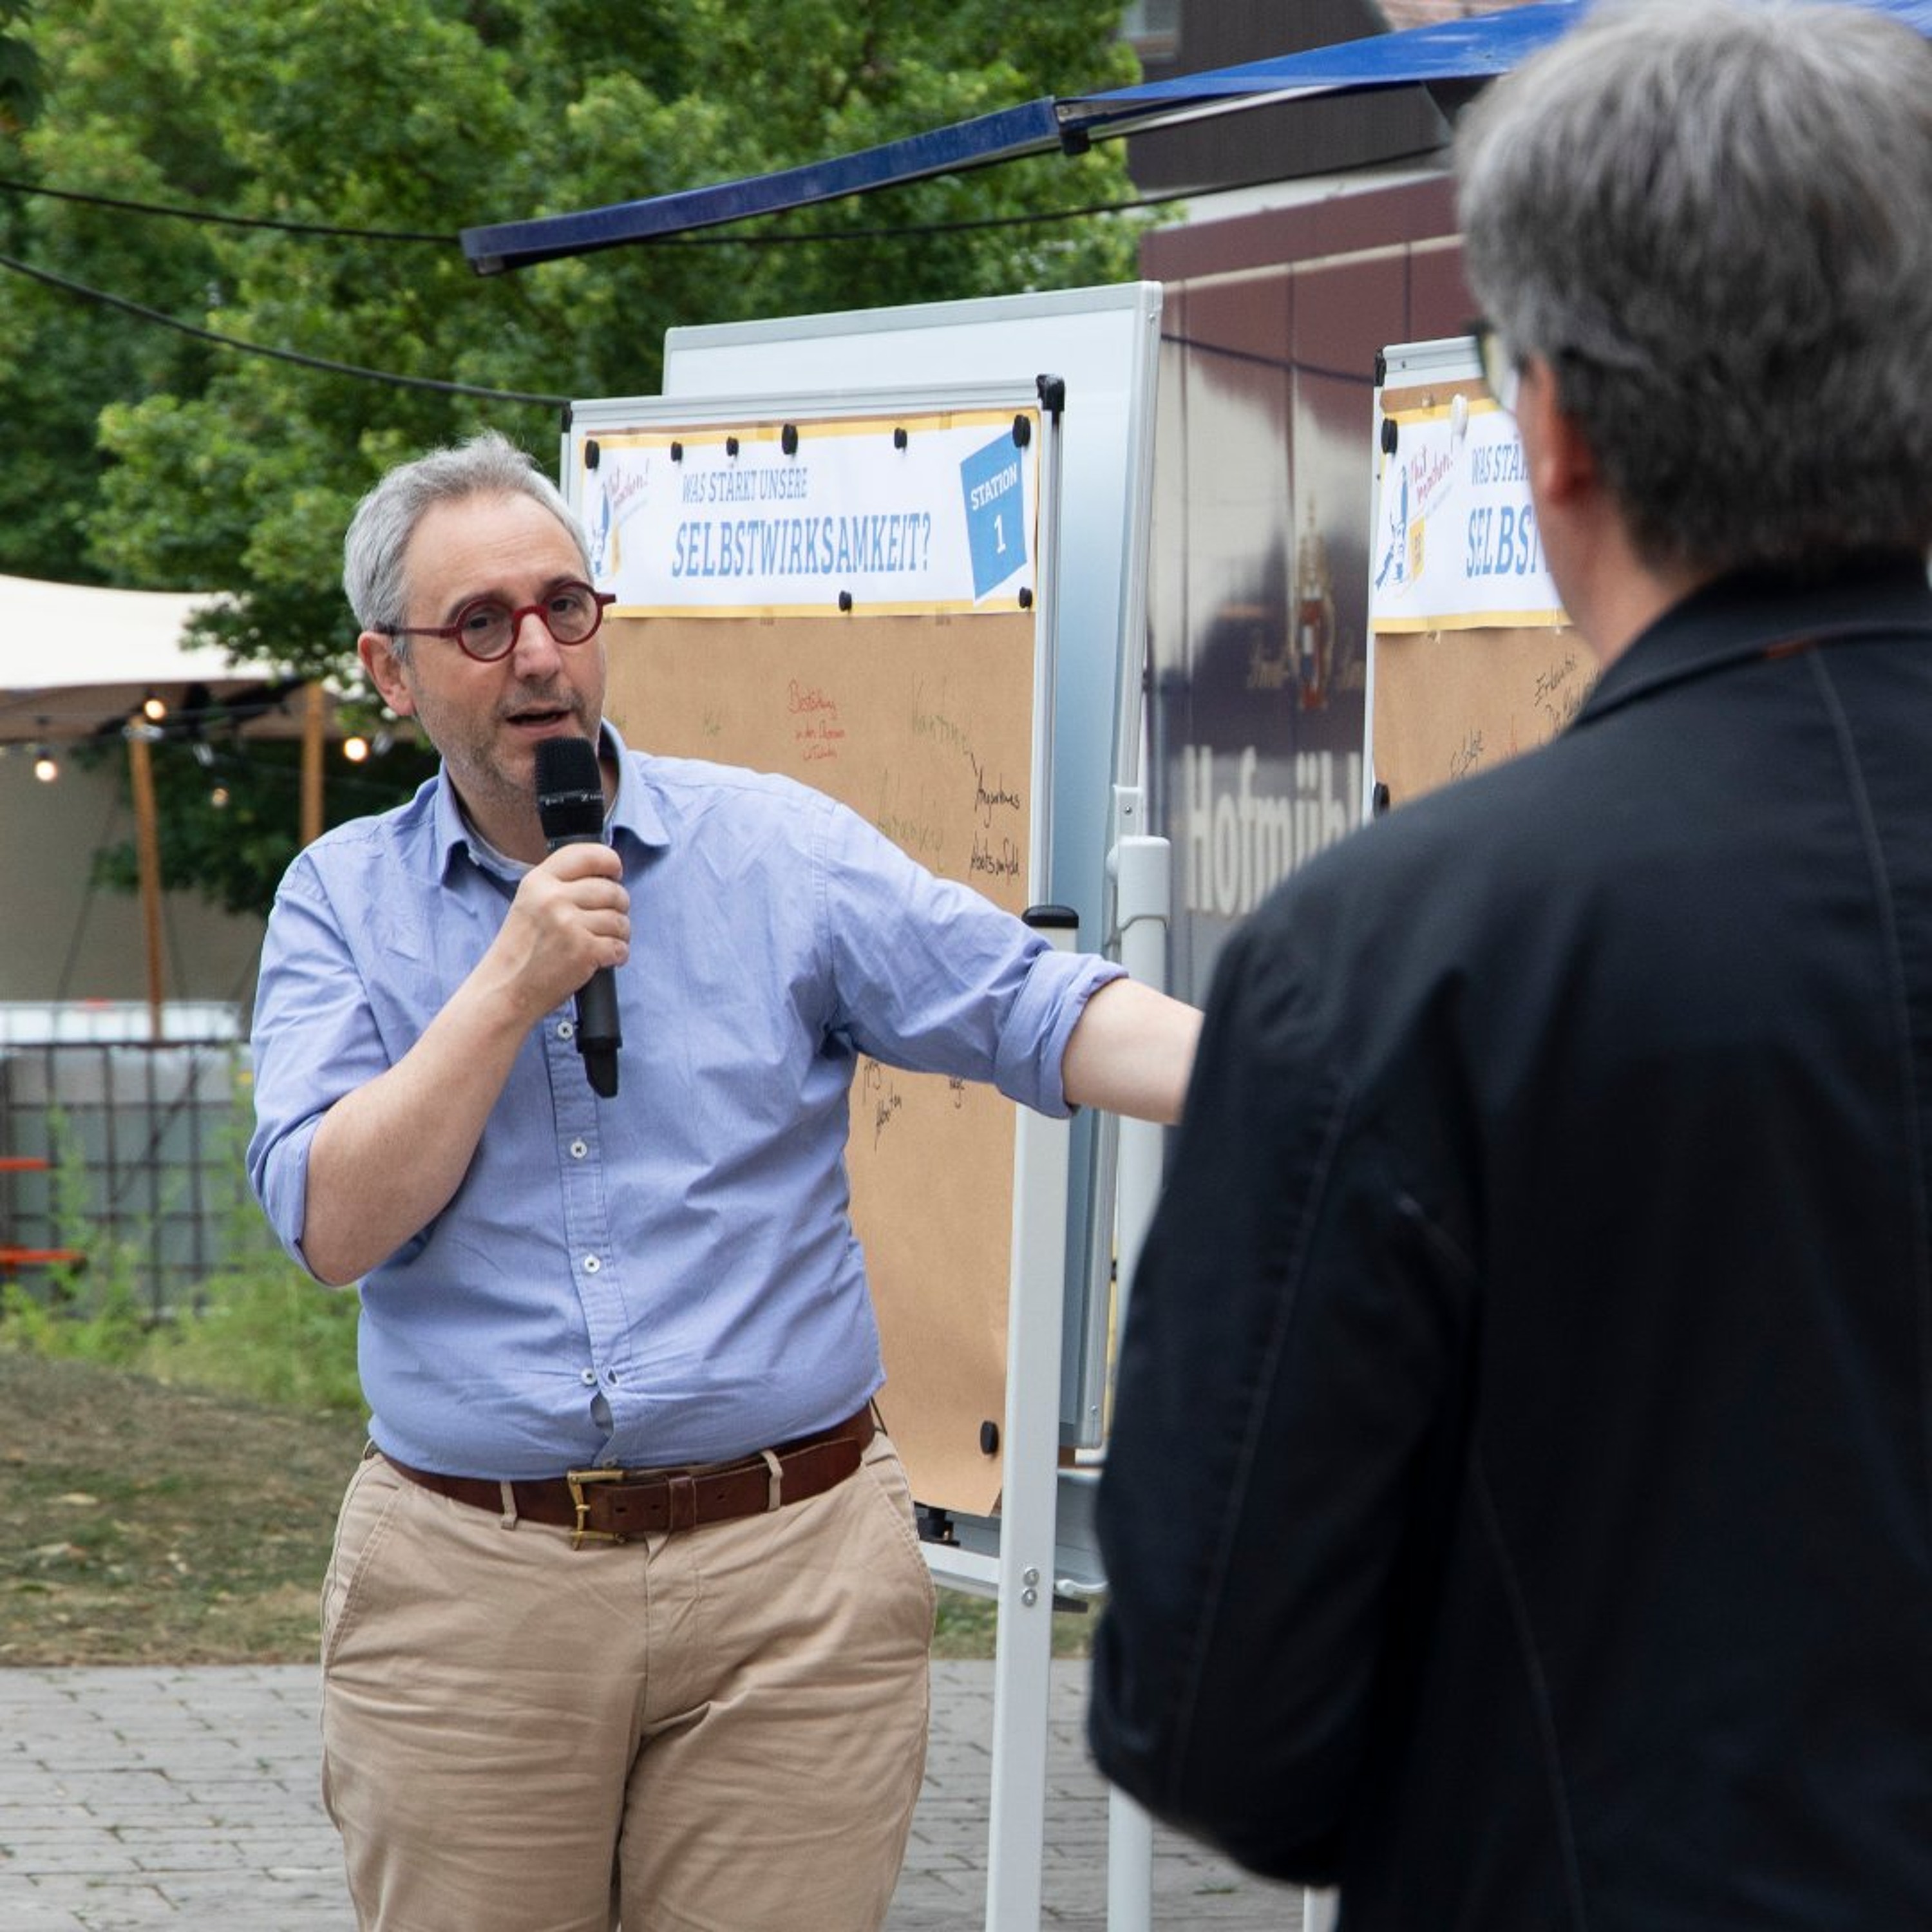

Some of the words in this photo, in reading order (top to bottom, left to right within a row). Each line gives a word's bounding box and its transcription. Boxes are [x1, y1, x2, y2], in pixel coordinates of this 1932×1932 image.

[683, 473, 706, 503] WAS
[708, 463, 757, 502] STÄRKT
[760, 467, 808, 500] UNSERE
[1472, 445, 1492, 485] WAS
[971, 462, 1018, 511] STATION
[672, 512, 931, 577] SELBSTWIRKSAMKEIT?
[994, 515, 1007, 554] 1
